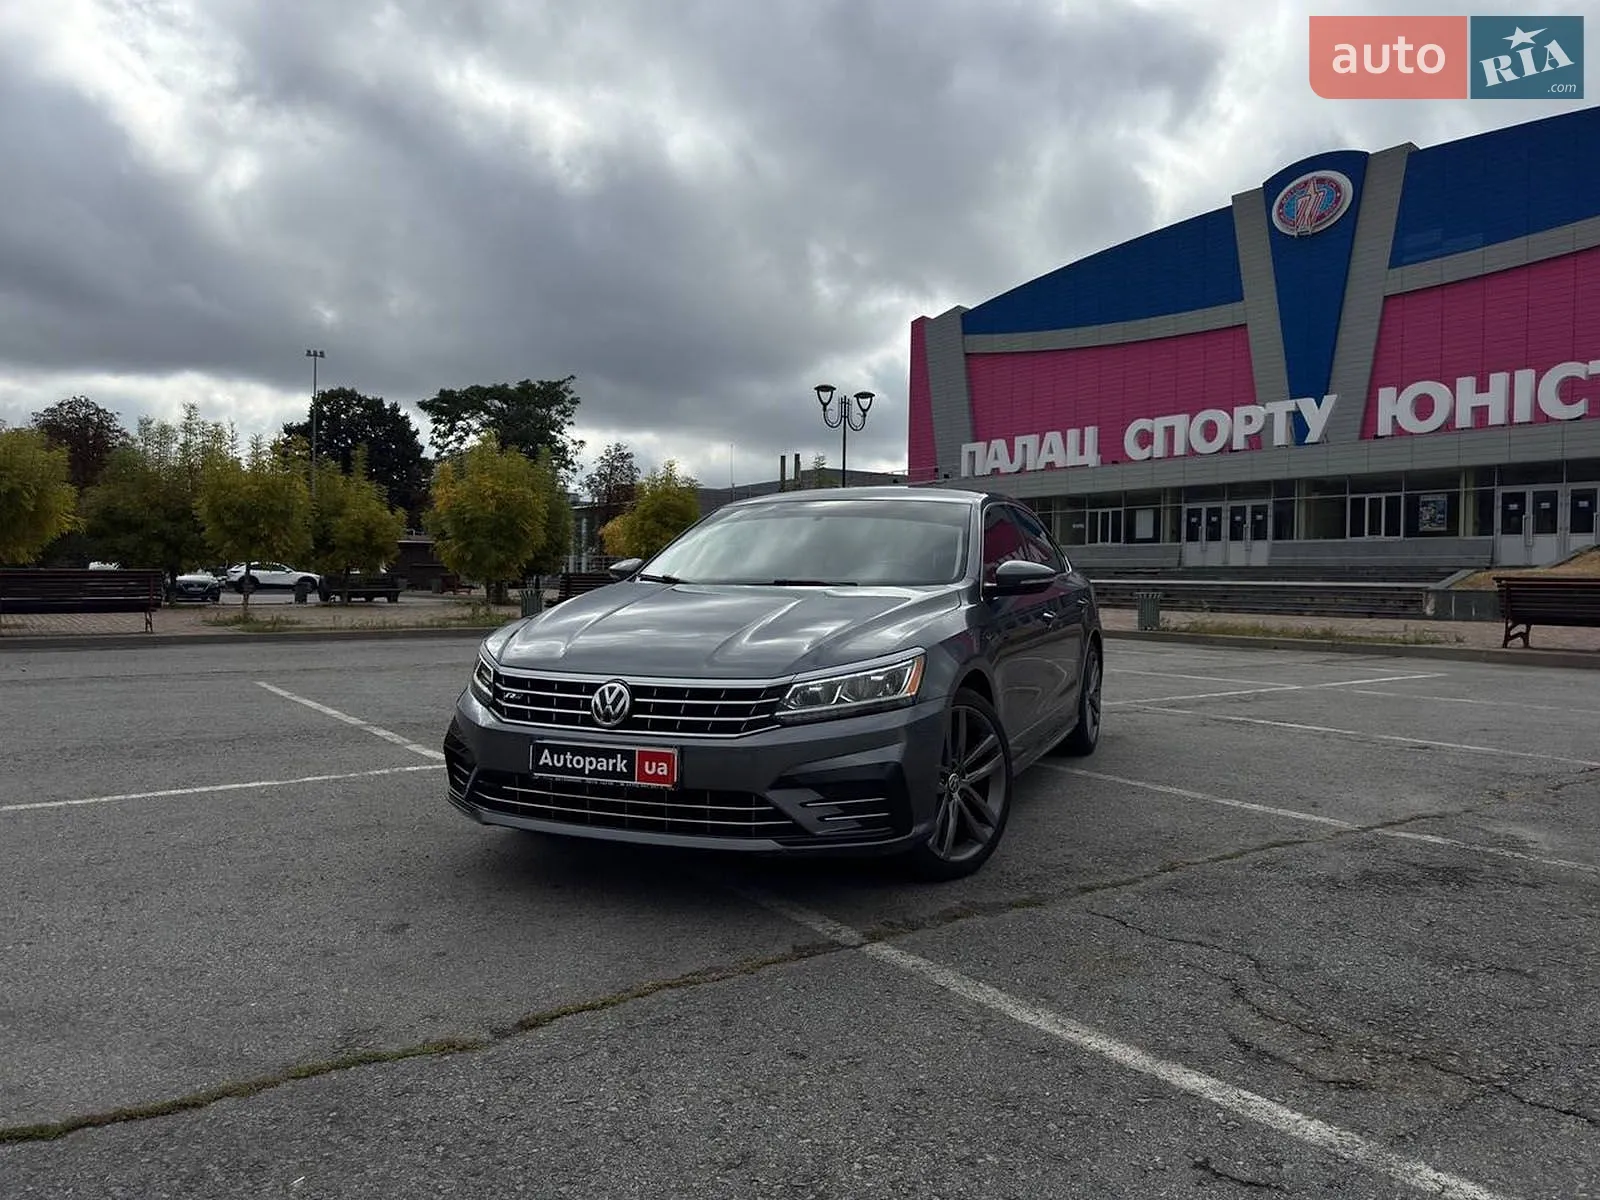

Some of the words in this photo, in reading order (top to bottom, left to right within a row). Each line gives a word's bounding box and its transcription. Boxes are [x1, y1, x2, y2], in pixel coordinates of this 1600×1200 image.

[961, 425, 1101, 478] ПАЛАЦ
[1124, 394, 1338, 461] СПОРТУ
[1377, 360, 1600, 437] ЮНІС
[538, 748, 628, 775] Autopark
[644, 760, 668, 776] ua
